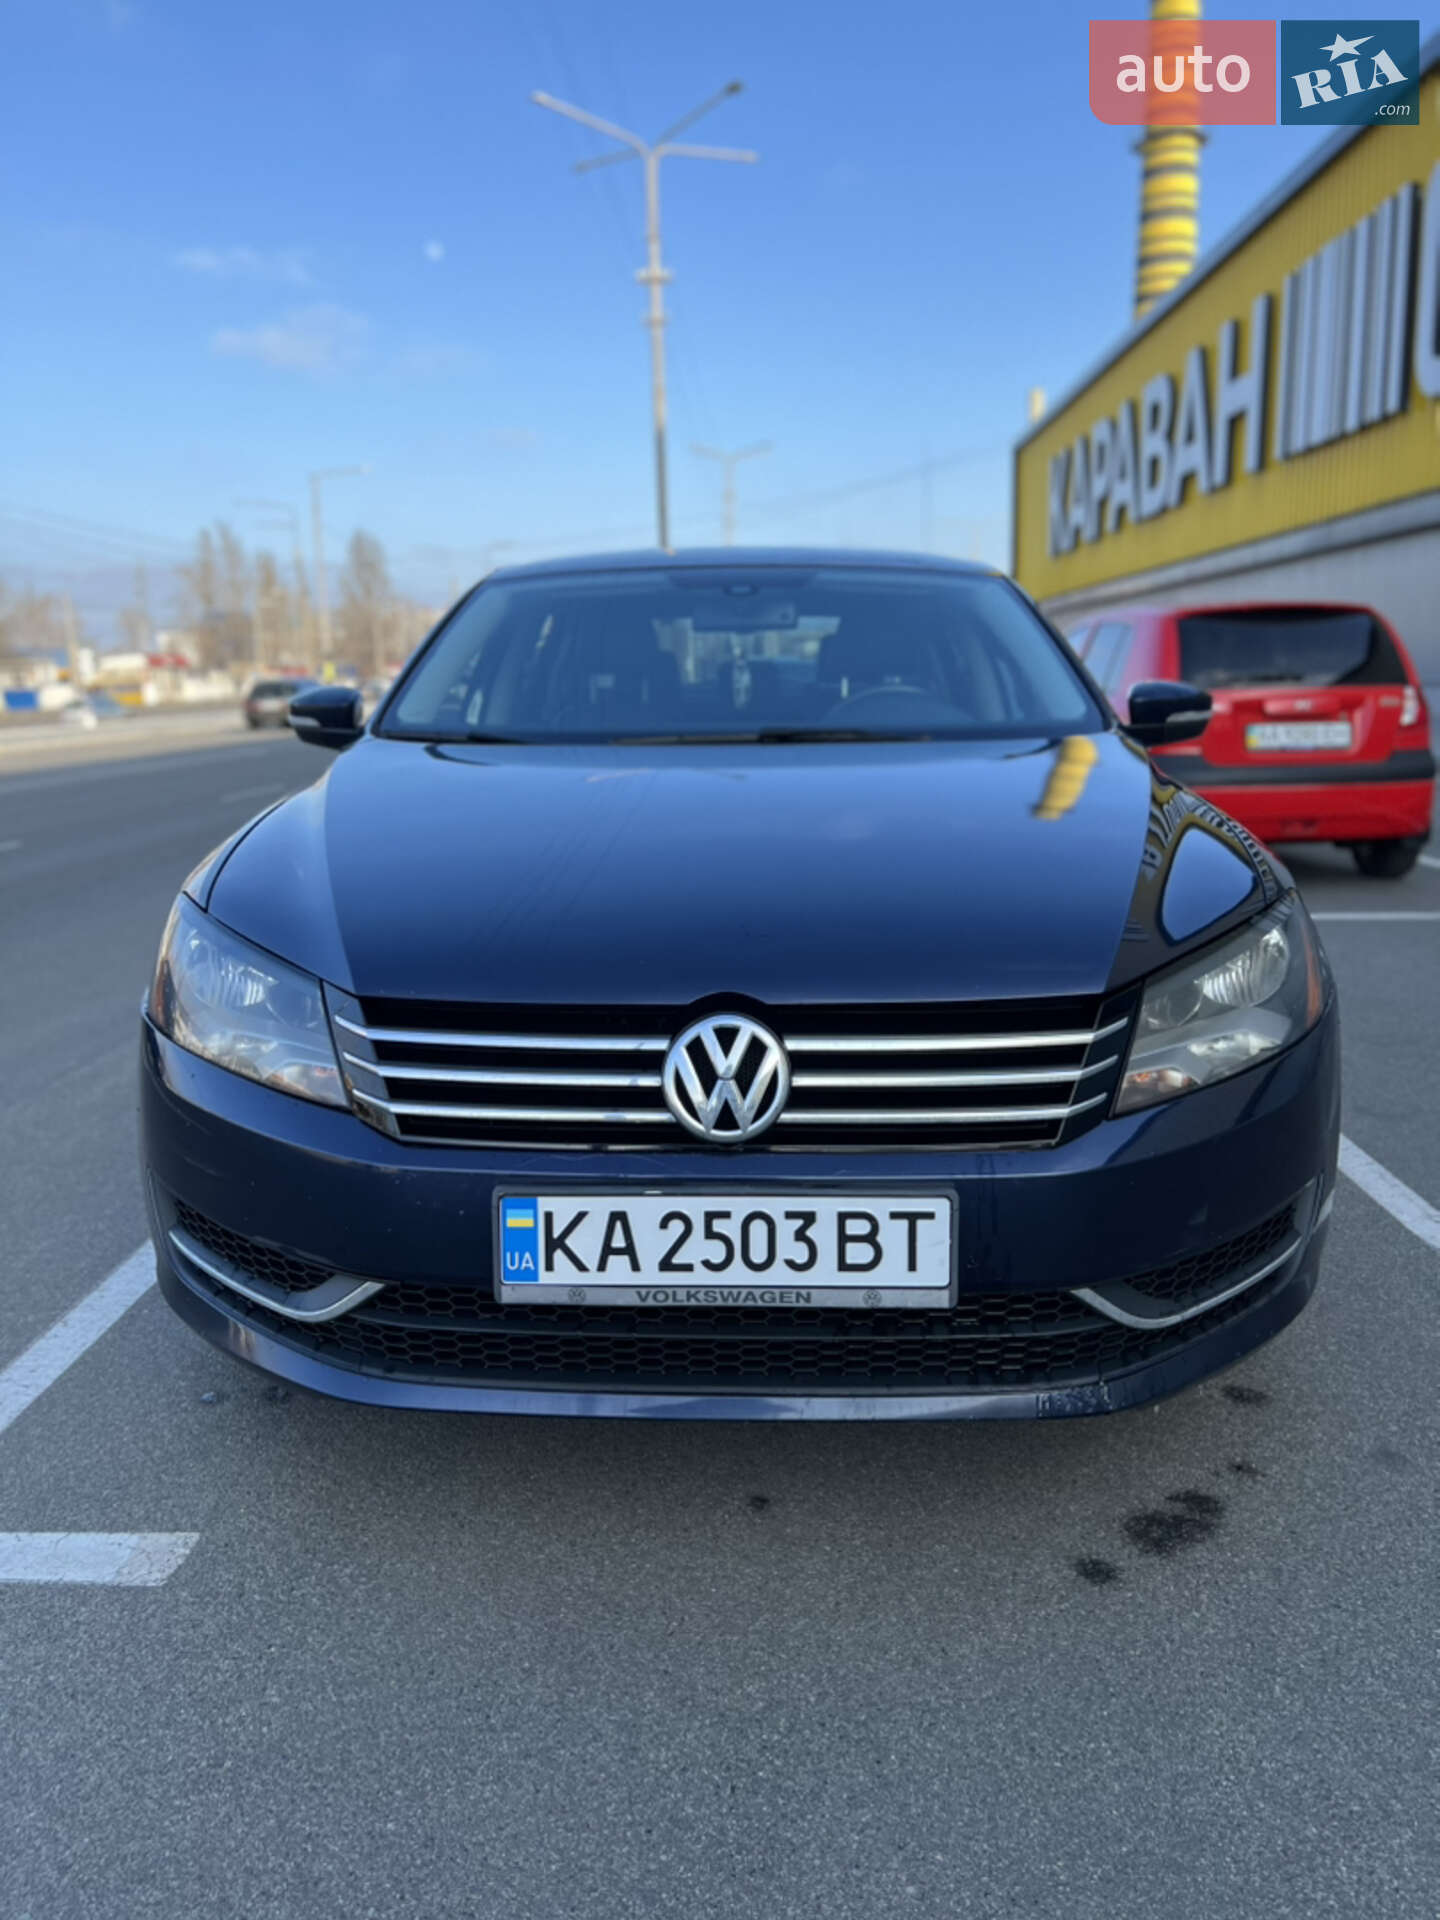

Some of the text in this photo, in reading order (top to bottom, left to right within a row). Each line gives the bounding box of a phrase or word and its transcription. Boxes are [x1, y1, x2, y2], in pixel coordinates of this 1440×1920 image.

[1048, 293, 1272, 559] КАРАВАН
[543, 1210, 936, 1273] KA 2503 BT
[506, 1253, 535, 1271] UA
[636, 1290, 812, 1304] VOLKSWAGEN
